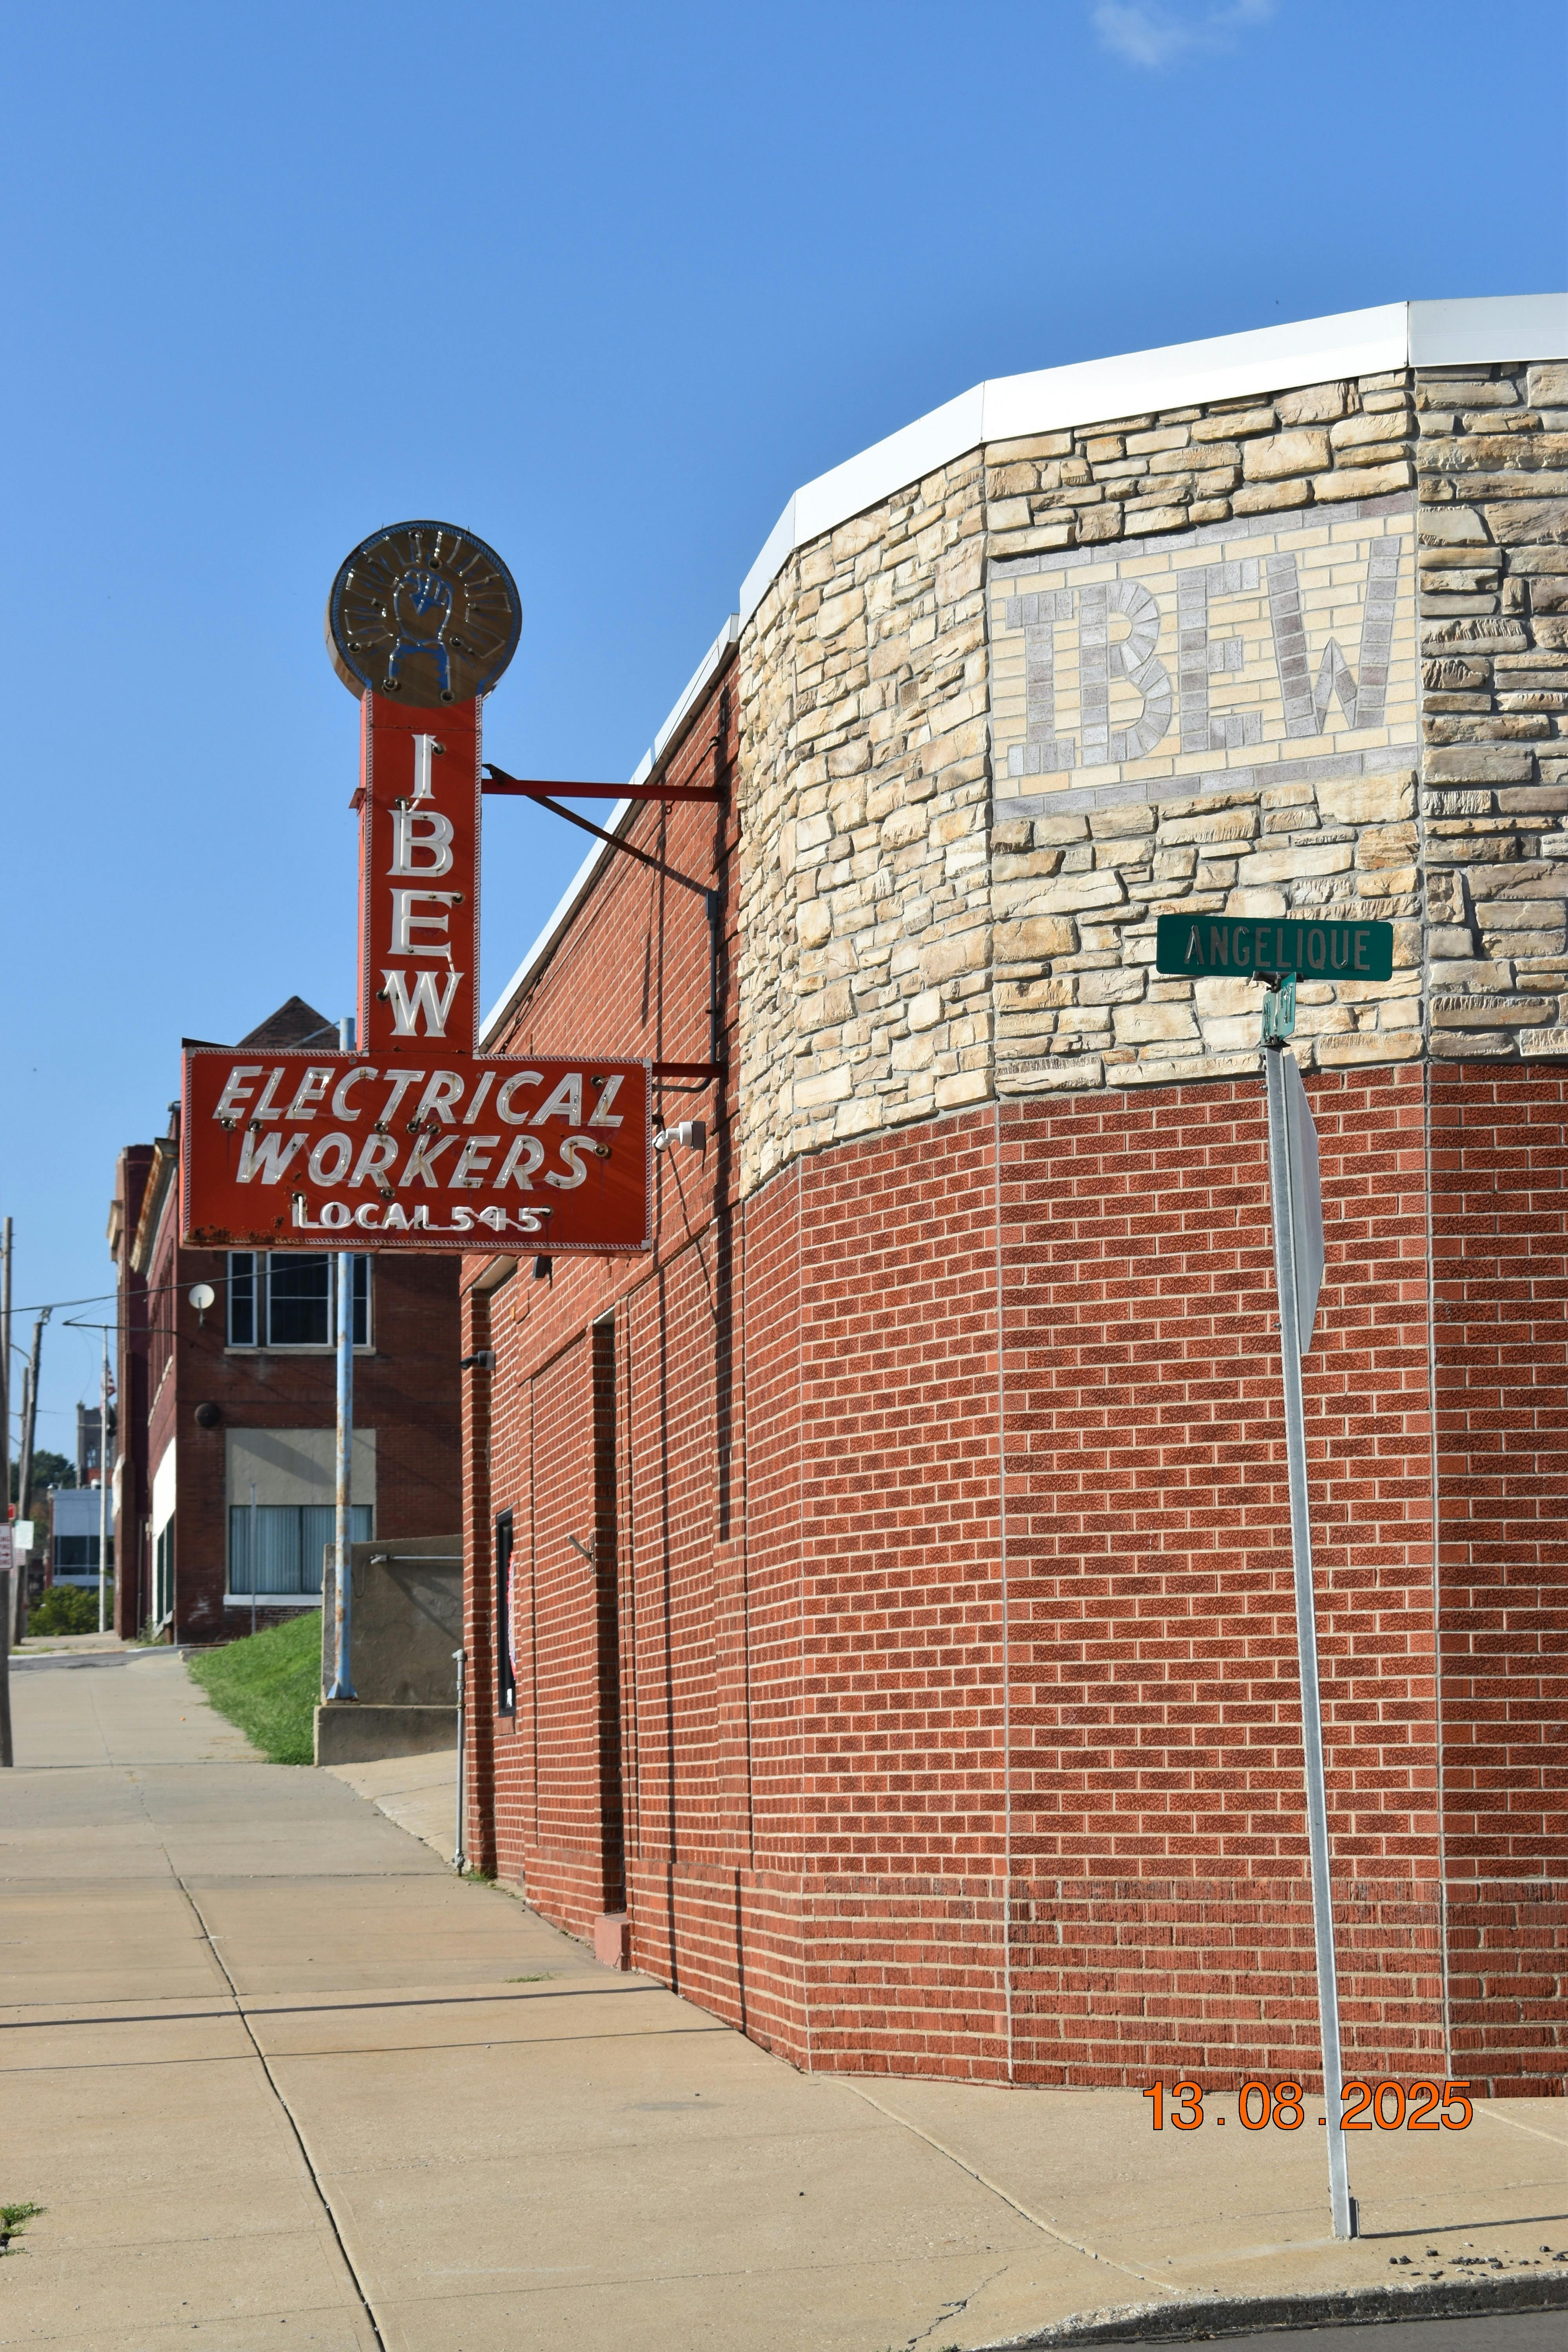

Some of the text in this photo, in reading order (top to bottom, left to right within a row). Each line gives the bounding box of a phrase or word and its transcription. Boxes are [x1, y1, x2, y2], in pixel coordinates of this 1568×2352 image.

[1006, 537, 1401, 777] IBEW
[379, 733, 465, 1037] IBEW
[1184, 925, 1370, 970] ANGELIQUE
[212, 1065, 624, 1127] ELECTRICAL
[236, 1131, 598, 1189] WORKERS
[292, 1201, 542, 1232] LOCAL 545
